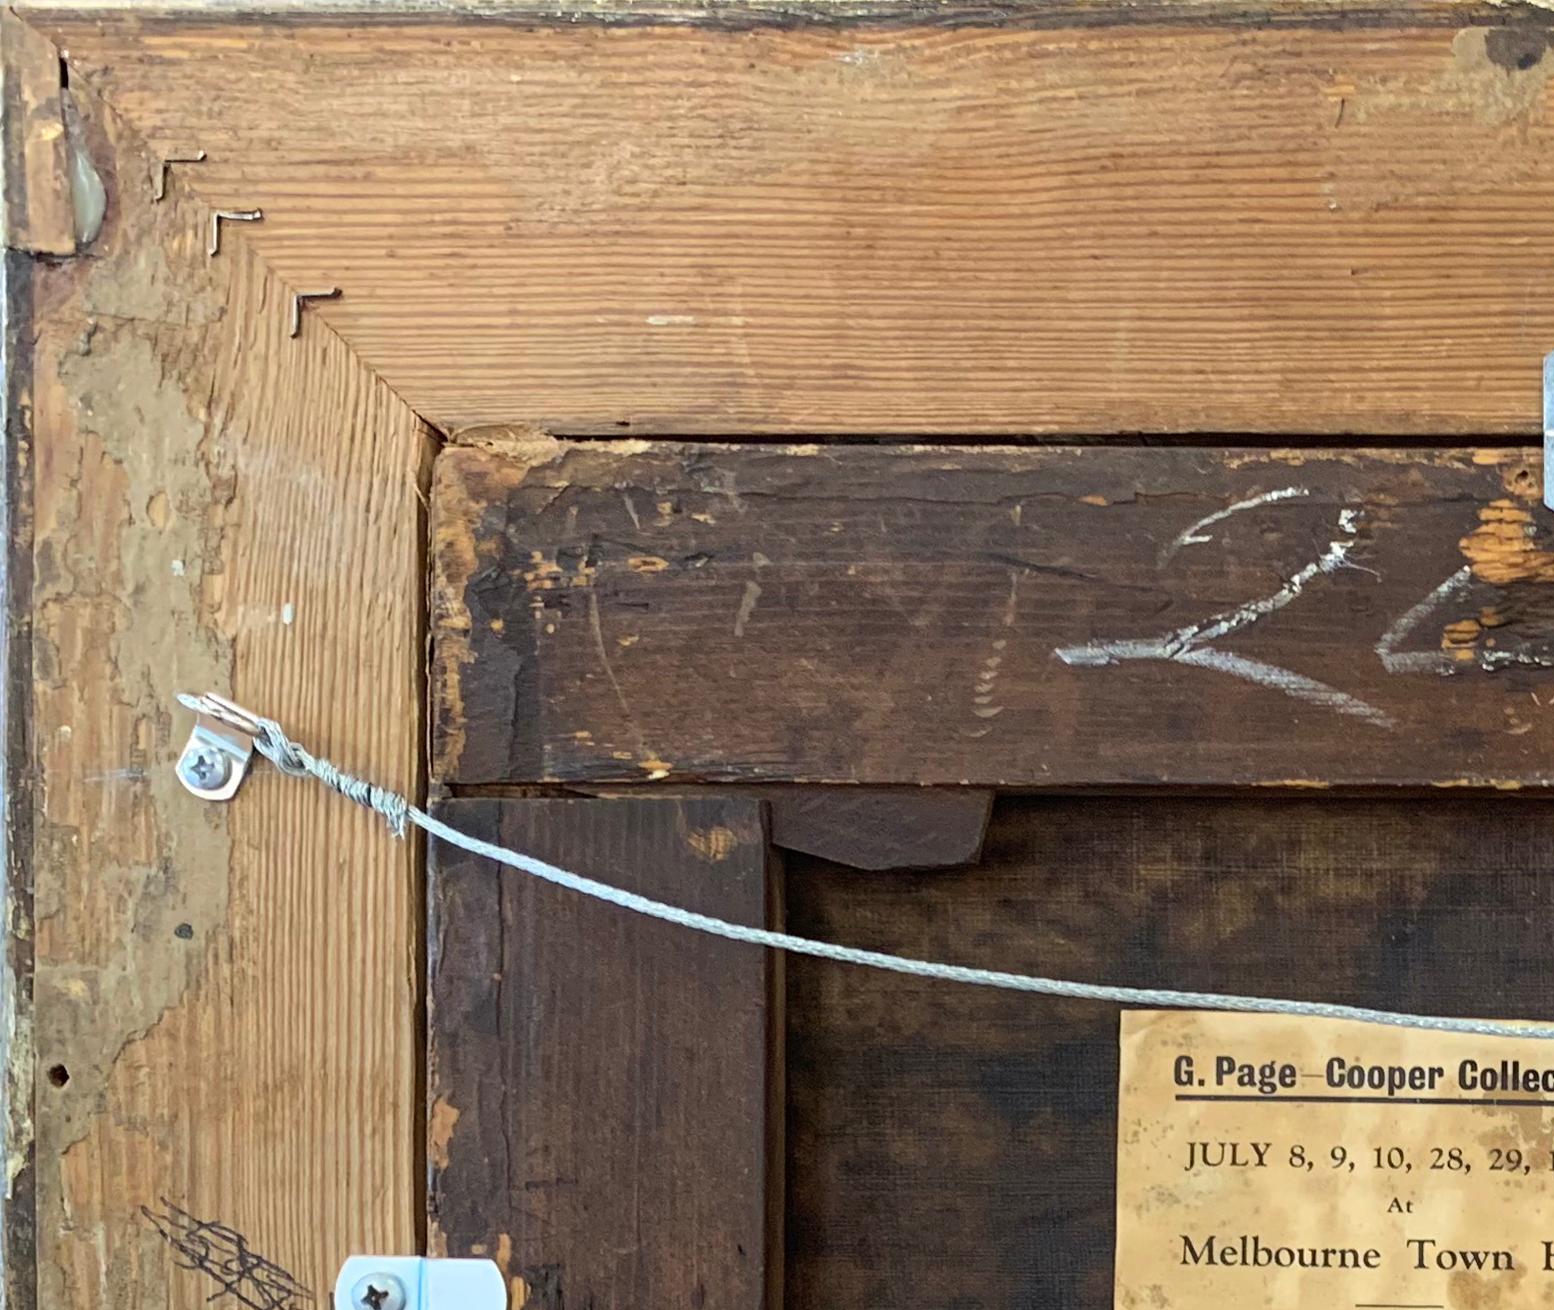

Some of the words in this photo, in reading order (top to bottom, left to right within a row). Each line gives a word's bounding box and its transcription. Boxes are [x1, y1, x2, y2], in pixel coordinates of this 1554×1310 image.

[1173, 1054, 1206, 1088] G.
[1183, 1141, 1273, 1172] JULY
[1288, 1144, 1314, 1173] 8,
[1330, 1145, 1356, 1173] 9,
[1373, 1146, 1413, 1174] 10,
[1429, 1147, 1472, 1175] 28,
[1488, 1147, 1531, 1176] 29,
[1386, 1195, 1415, 1215] At
[1179, 1234, 1382, 1270] Melbourne
[1406, 1238, 1517, 1272] Town
